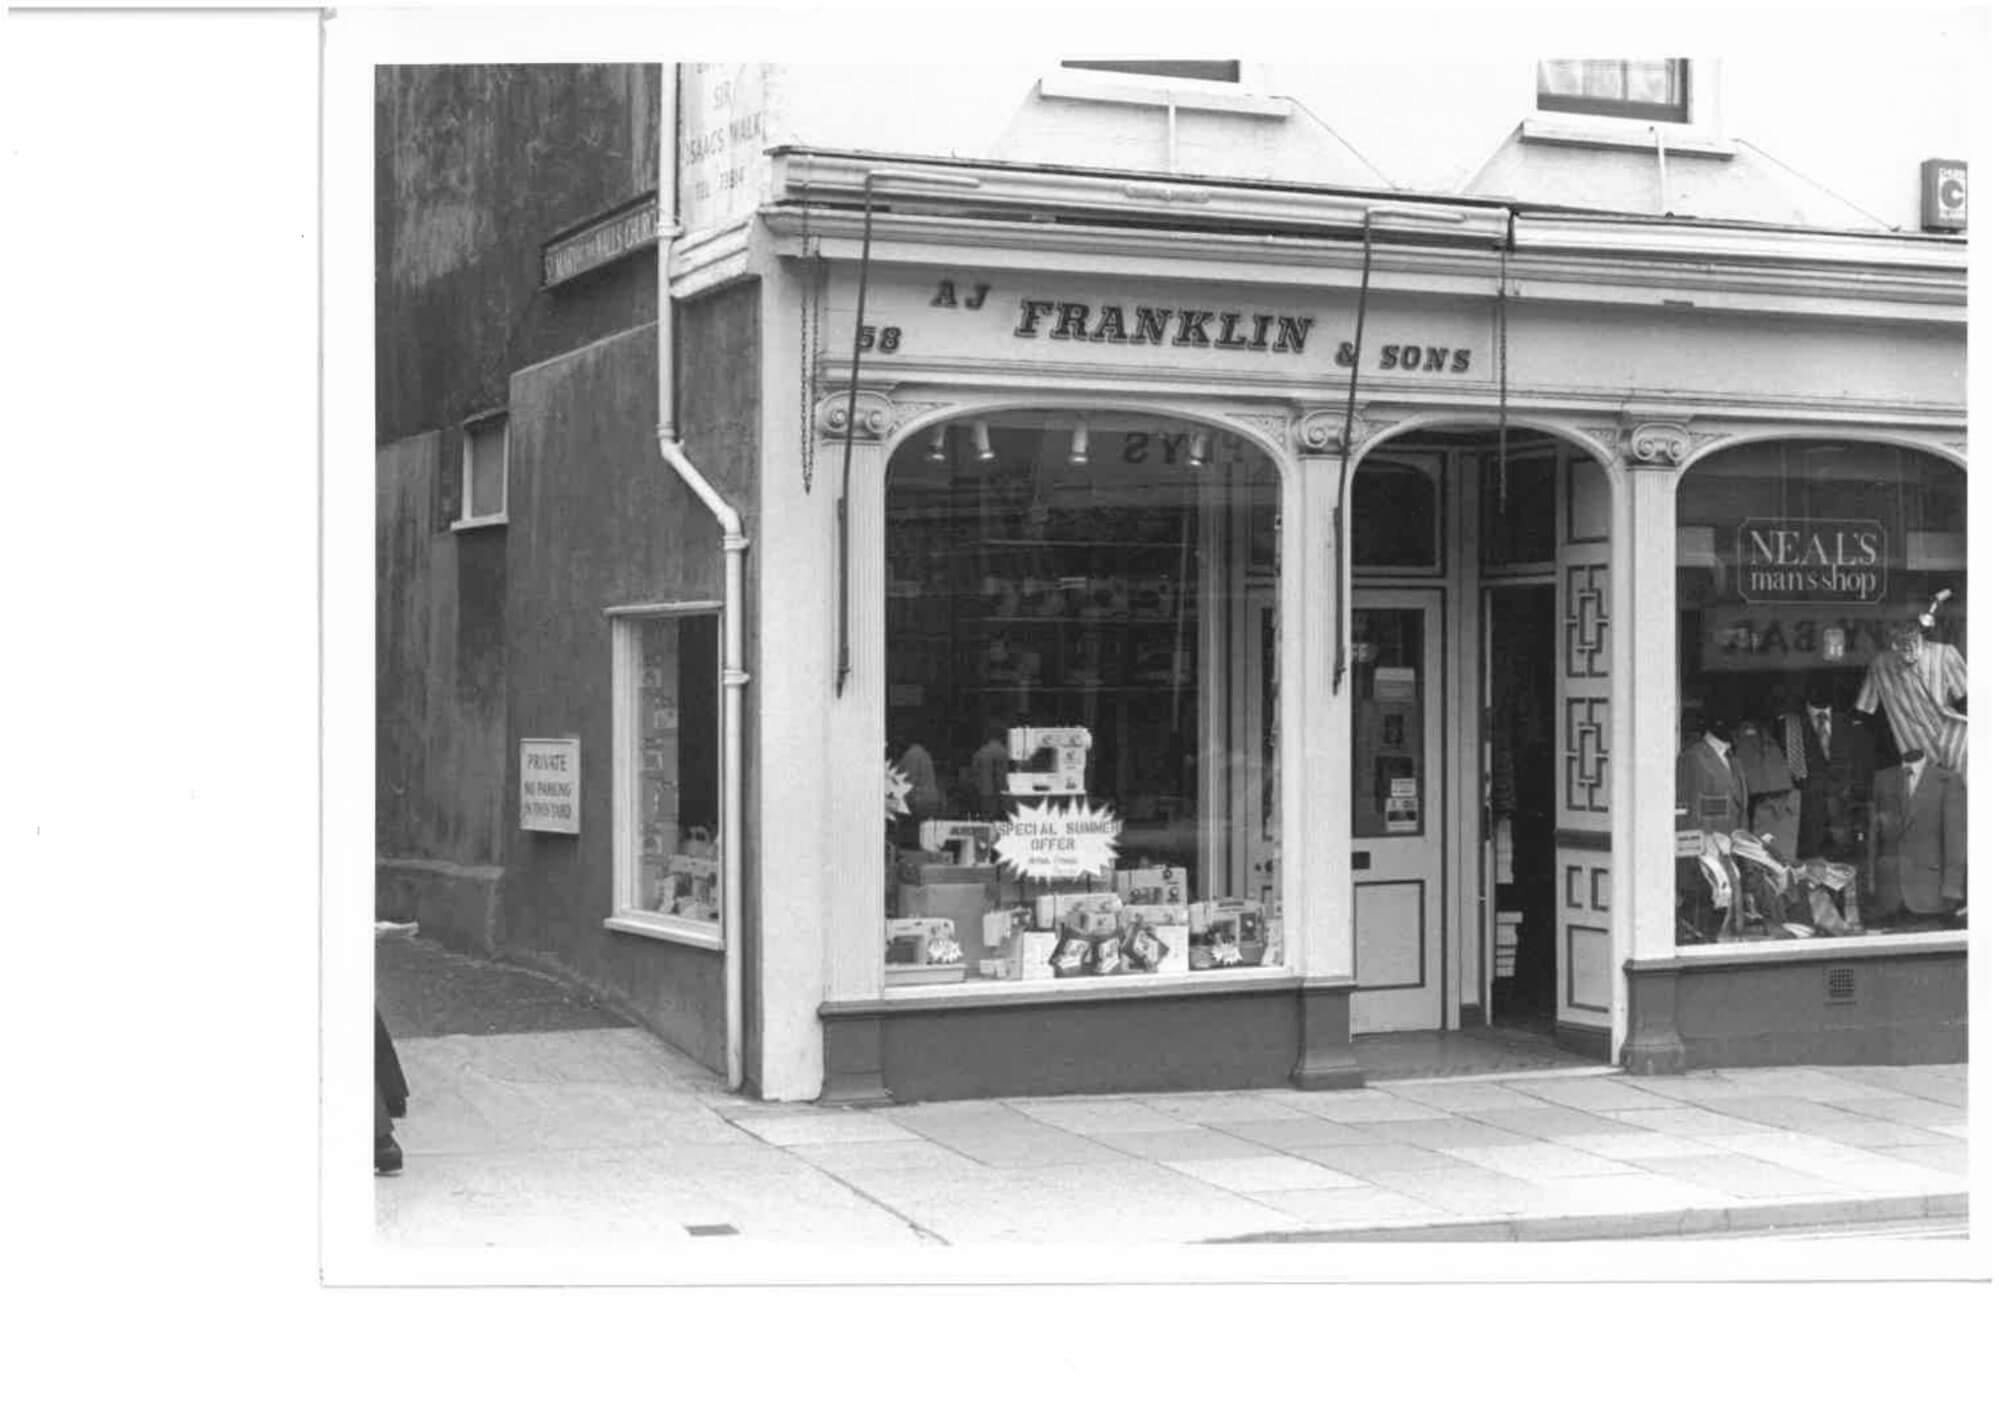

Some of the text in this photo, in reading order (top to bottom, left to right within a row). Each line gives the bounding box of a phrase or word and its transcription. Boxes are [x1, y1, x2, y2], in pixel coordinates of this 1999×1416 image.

[857, 325, 902, 354] 58
[1013, 299, 1315, 355] FRANKLIN
[1334, 341, 1472, 374] & SONS
[1751, 530, 1877, 566] NEAL'S
[1821, 562, 1877, 600] shop
[527, 753, 568, 772] PRIVATE
[537, 781, 572, 798] PARKING
[998, 821, 1058, 836] SPECIAL
[1065, 820, 1122, 835] SUMMER
[1031, 837, 1075, 851] OFFER
